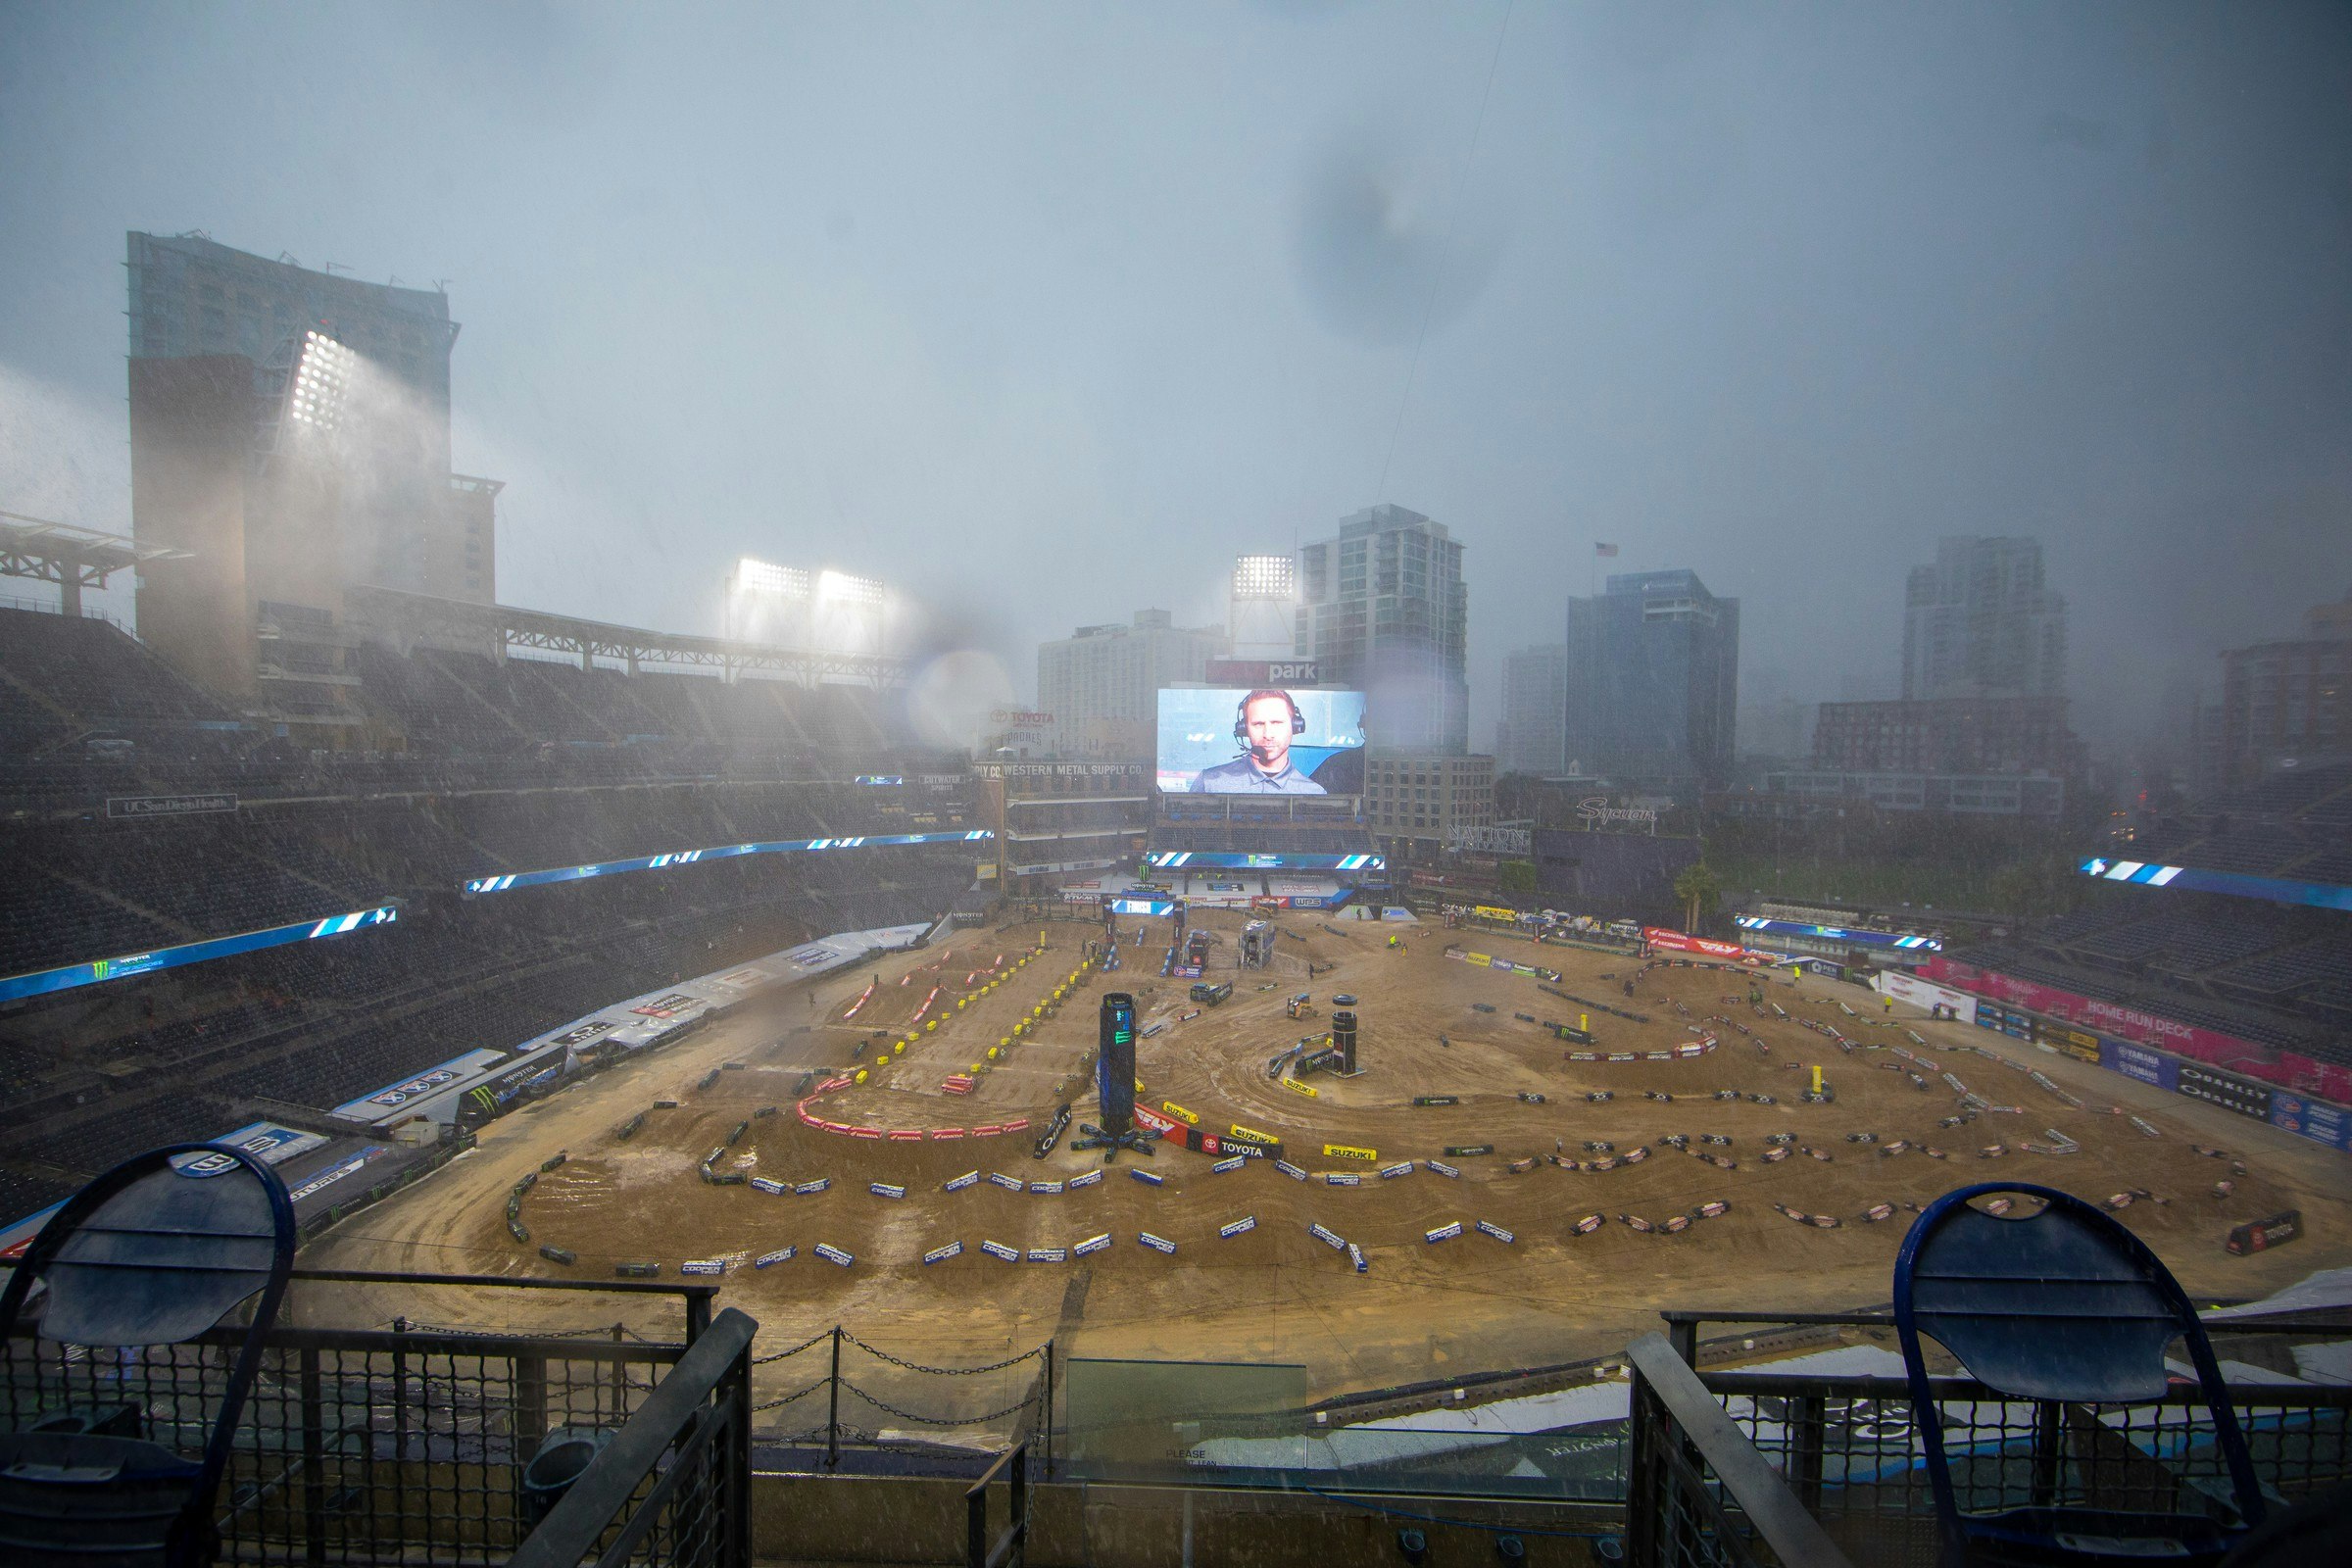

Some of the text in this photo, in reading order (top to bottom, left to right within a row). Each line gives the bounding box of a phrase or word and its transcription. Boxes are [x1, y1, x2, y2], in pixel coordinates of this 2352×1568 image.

[1269, 663, 1315, 682] park
[1010, 711, 1054, 723] TOYOTA
[1004, 764, 1144, 775] WESTERN METAL SUPPLY CO.
[1577, 797, 1657, 825] Sycuan
[1295, 897, 1322, 907] WPS
[1658, 931, 1688, 940] HONDA
[2088, 1001, 2193, 1040] HOME RUN DECK
[502, 1065, 537, 1083] MONSTER
[1286, 1078, 1311, 1094] SUZUKI
[2203, 1075, 2266, 1099] OAKLEY
[2202, 1091, 2266, 1116] OAKLEY
[1137, 1108, 1175, 1132] FLY
[1166, 1104, 1191, 1122] SUZUKI
[1222, 1142, 1263, 1156] TOYOTA
[1330, 1149, 1371, 1159] SUZUKI
[1215, 1159, 1244, 1171] COOPER
[1278, 1164, 1306, 1179] COOPER
[1384, 1165, 1412, 1177] COOPER
[1431, 1164, 1458, 1176] COOPER
[291, 1167, 351, 1200] UTURES
[753, 1181, 782, 1192] COOPER
[796, 1182, 824, 1193] COOPER
[948, 1174, 978, 1190] COOPER
[991, 1176, 1022, 1189] COOPER
[1071, 1174, 1102, 1187] COOPER
[871, 1187, 903, 1196] COOPER
[1222, 1219, 1253, 1235] COOPER
[1429, 1226, 1460, 1240] COOPER
[1481, 1225, 1513, 1240] COOPER
[2265, 1223, 2293, 1240] TOYOTA
[1141, 1236, 1175, 1250] COOPER
[1313, 1228, 1344, 1247] COOPER
[925, 1245, 960, 1261] COOPER
[983, 1244, 1018, 1259] COOPER
[1077, 1238, 1109, 1253] COOPER
[757, 1250, 792, 1264] COOPER
[815, 1248, 851, 1263] COOPER
[1166, 1449, 1206, 1458] PLEASE
